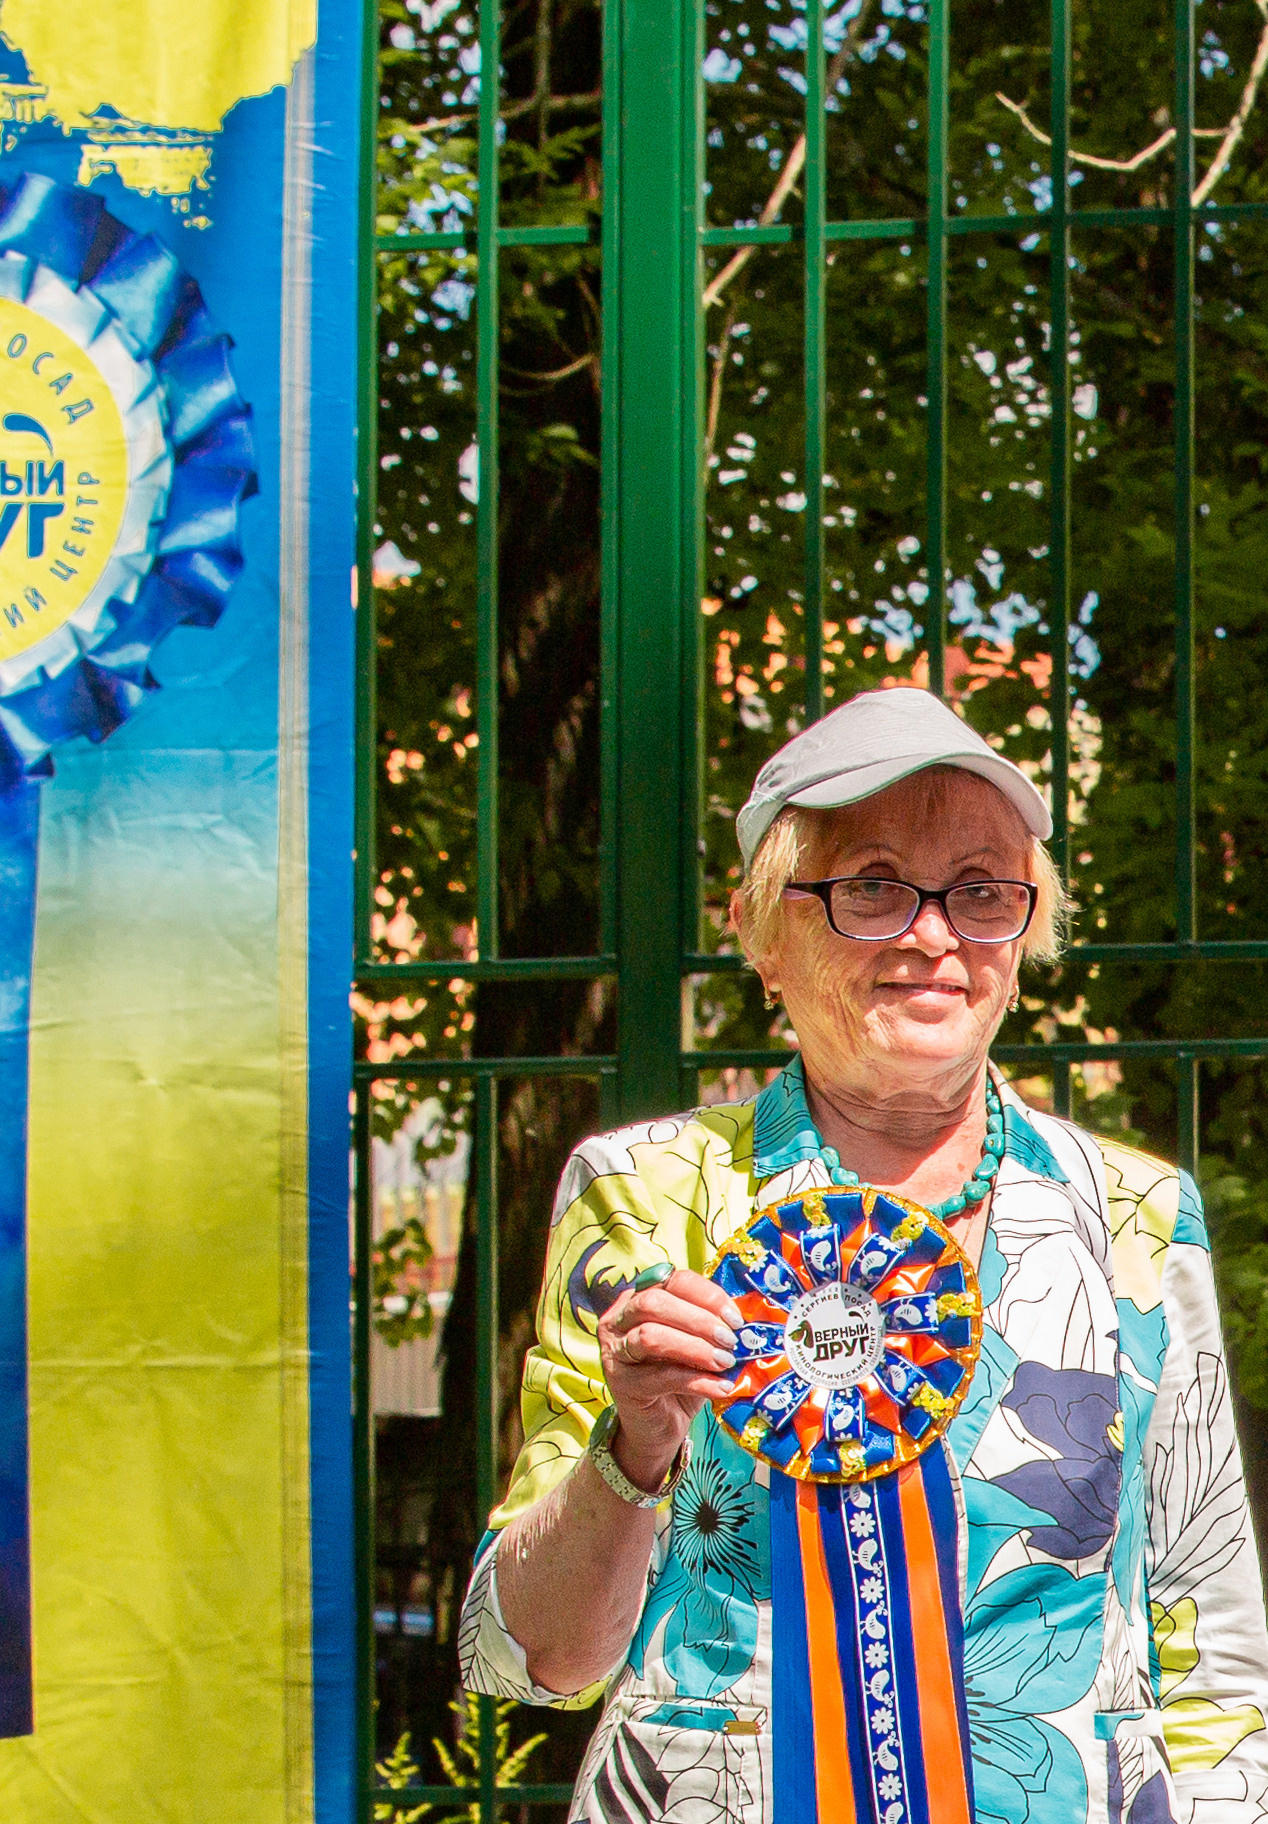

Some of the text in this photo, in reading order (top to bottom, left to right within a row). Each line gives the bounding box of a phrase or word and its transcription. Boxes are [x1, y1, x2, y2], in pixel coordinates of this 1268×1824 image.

[50, 471, 100, 581] ЦЕНТР
[802, 1293, 871, 1317] СЕРГИЕВ ПОСАД
[814, 1323, 869, 1343] ВЕРНЫЙ
[795, 1344, 868, 1380] КИНОЛОГИЧЕСКИЙ
[867, 1326, 876, 1358] ЦЕНТР
[813, 1335, 870, 1363] ДРУГ
